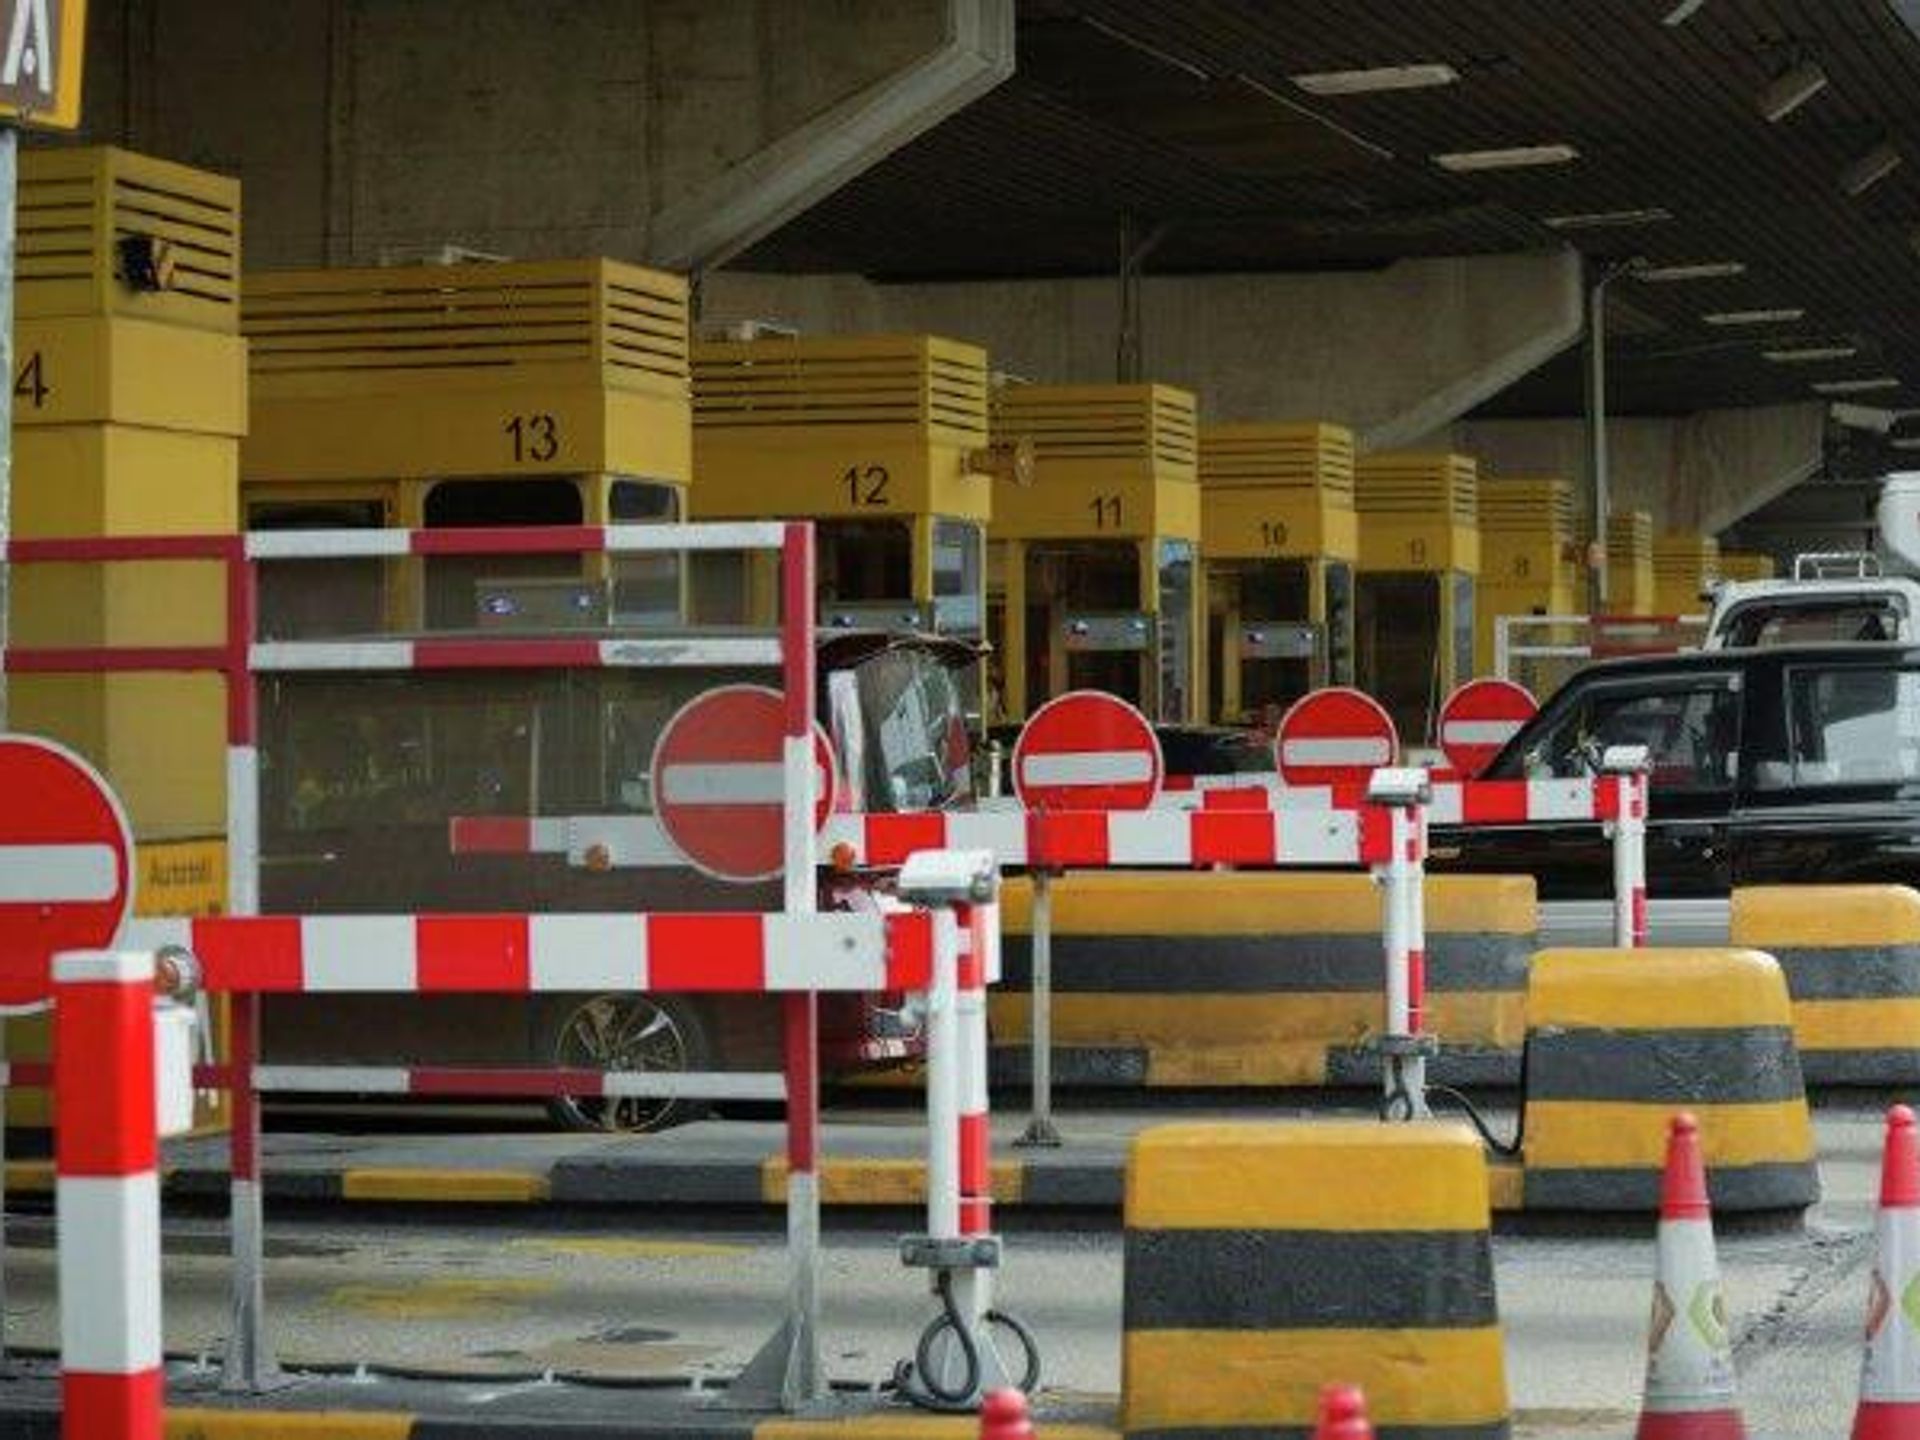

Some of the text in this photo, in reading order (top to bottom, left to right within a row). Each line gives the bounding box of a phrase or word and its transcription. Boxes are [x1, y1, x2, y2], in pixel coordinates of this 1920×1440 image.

[504, 415, 559, 462] 13
[842, 466, 889, 506] 12
[1087, 495, 1122, 530] 11
